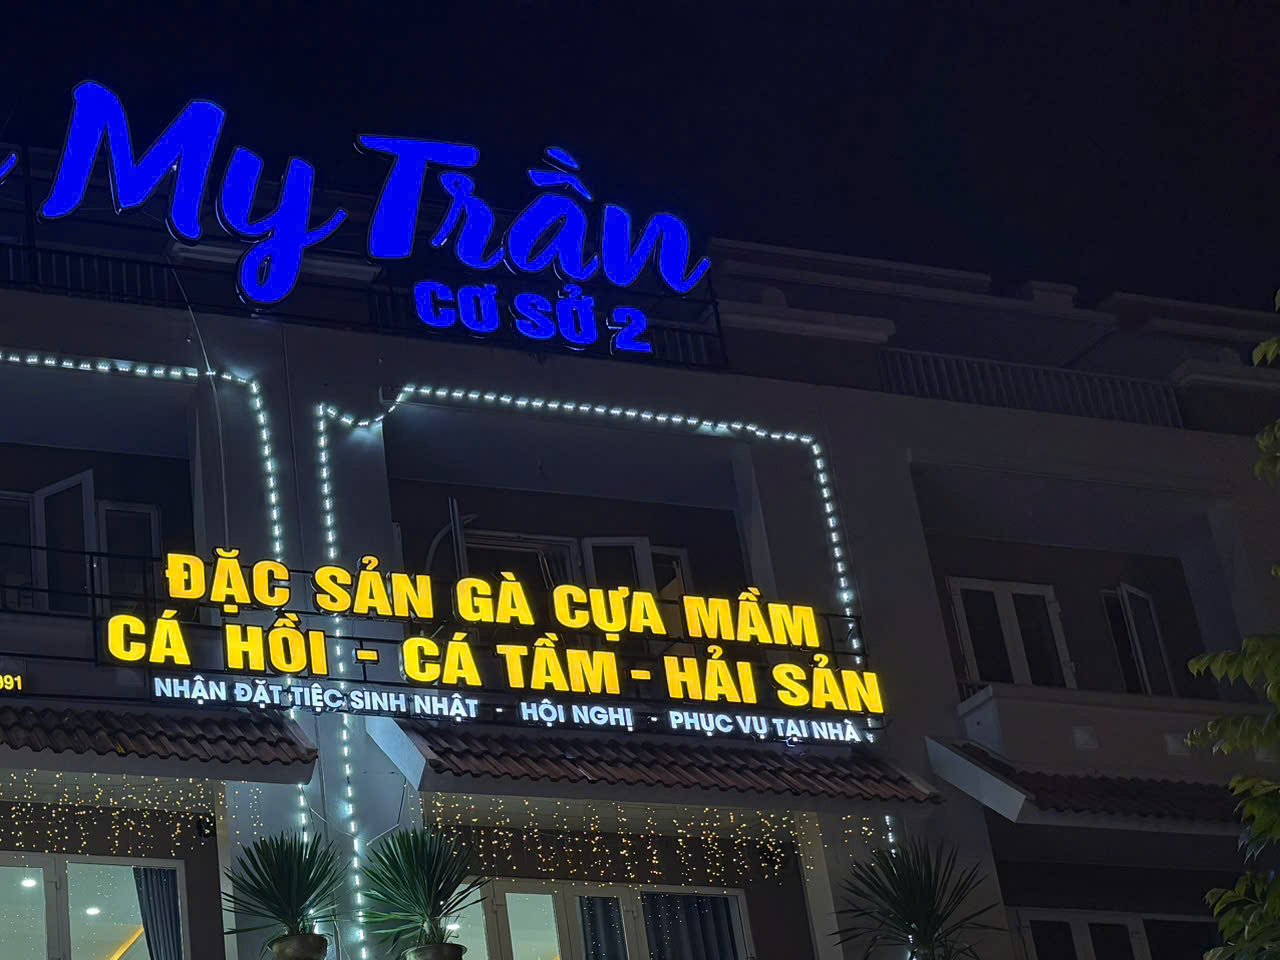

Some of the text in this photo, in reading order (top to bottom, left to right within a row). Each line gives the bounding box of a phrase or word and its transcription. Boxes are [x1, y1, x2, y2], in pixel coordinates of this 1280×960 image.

[42, 81, 346, 303] My
[358, 135, 711, 293] Trần
[414, 281, 652, 353] CƠ SỞ 2
[165, 548, 820, 648] ĐẶC SẢN GÀ CỰA MẦM
[107, 609, 191, 665] CÁ
[225, 612, 328, 675] HỒI
[402, 631, 482, 686] CÁ
[495, 632, 621, 695] TẦM
[663, 644, 757, 704] HẢI
[772, 653, 884, 714] SẢN
[154, 674, 227, 705] NHẬN
[233, 679, 283, 709] ĐẶT
[290, 684, 348, 713] TIỆC
[349, 690, 407, 713] SINH
[413, 692, 479, 722] NHẬT
[520, 698, 565, 727] HỘI
[571, 704, 634, 732] NGHỊ
[668, 710, 734, 737] PHỤC
[735, 715, 768, 740] VỤ
[775, 718, 809, 743] TẠI
[813, 718, 861, 743] NHÀ
